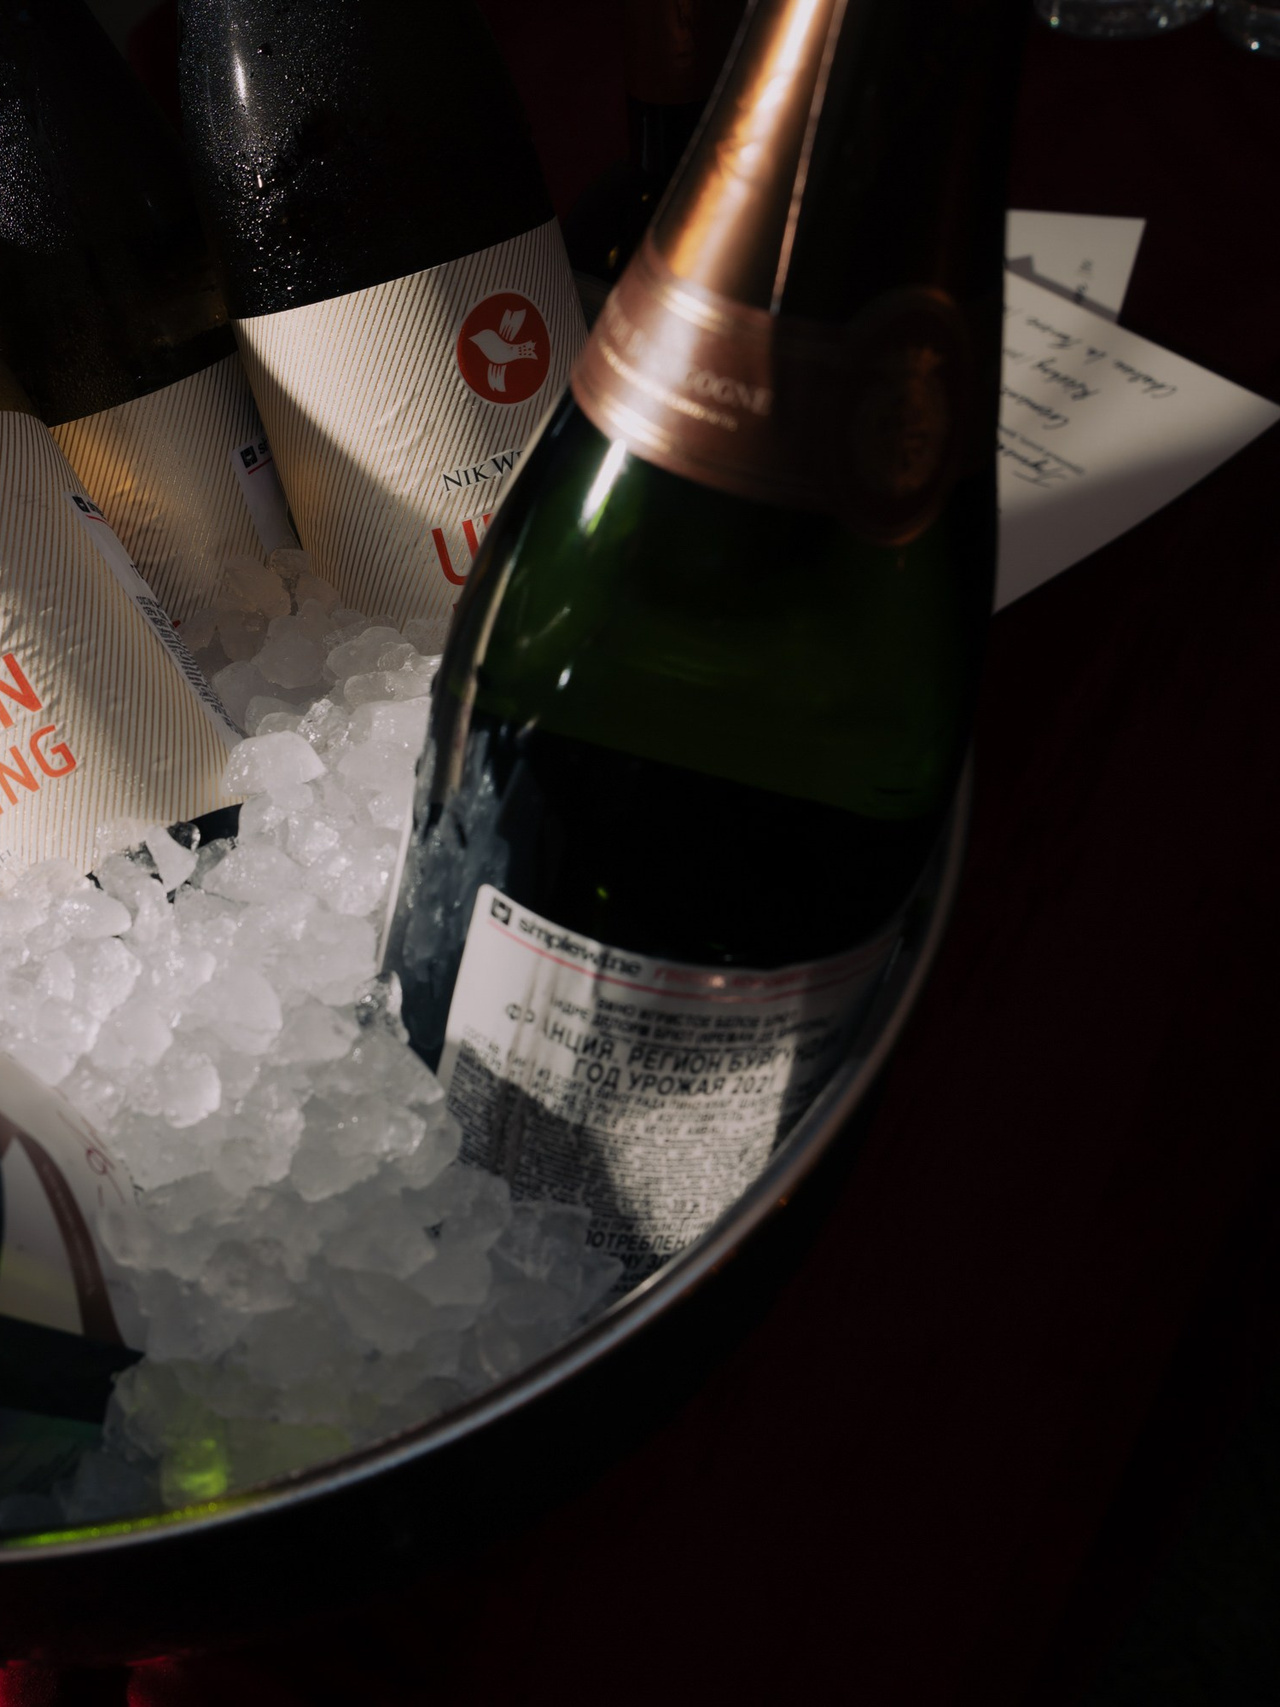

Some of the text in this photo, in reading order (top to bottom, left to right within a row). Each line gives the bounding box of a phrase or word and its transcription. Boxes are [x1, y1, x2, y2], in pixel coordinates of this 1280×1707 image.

[443, 465, 490, 492] NIK
[626, 1048, 721, 1073] РЕГИОН
[571, 1059, 621, 1090] ГОД
[626, 1071, 726, 1096] УРОЖАЯ
